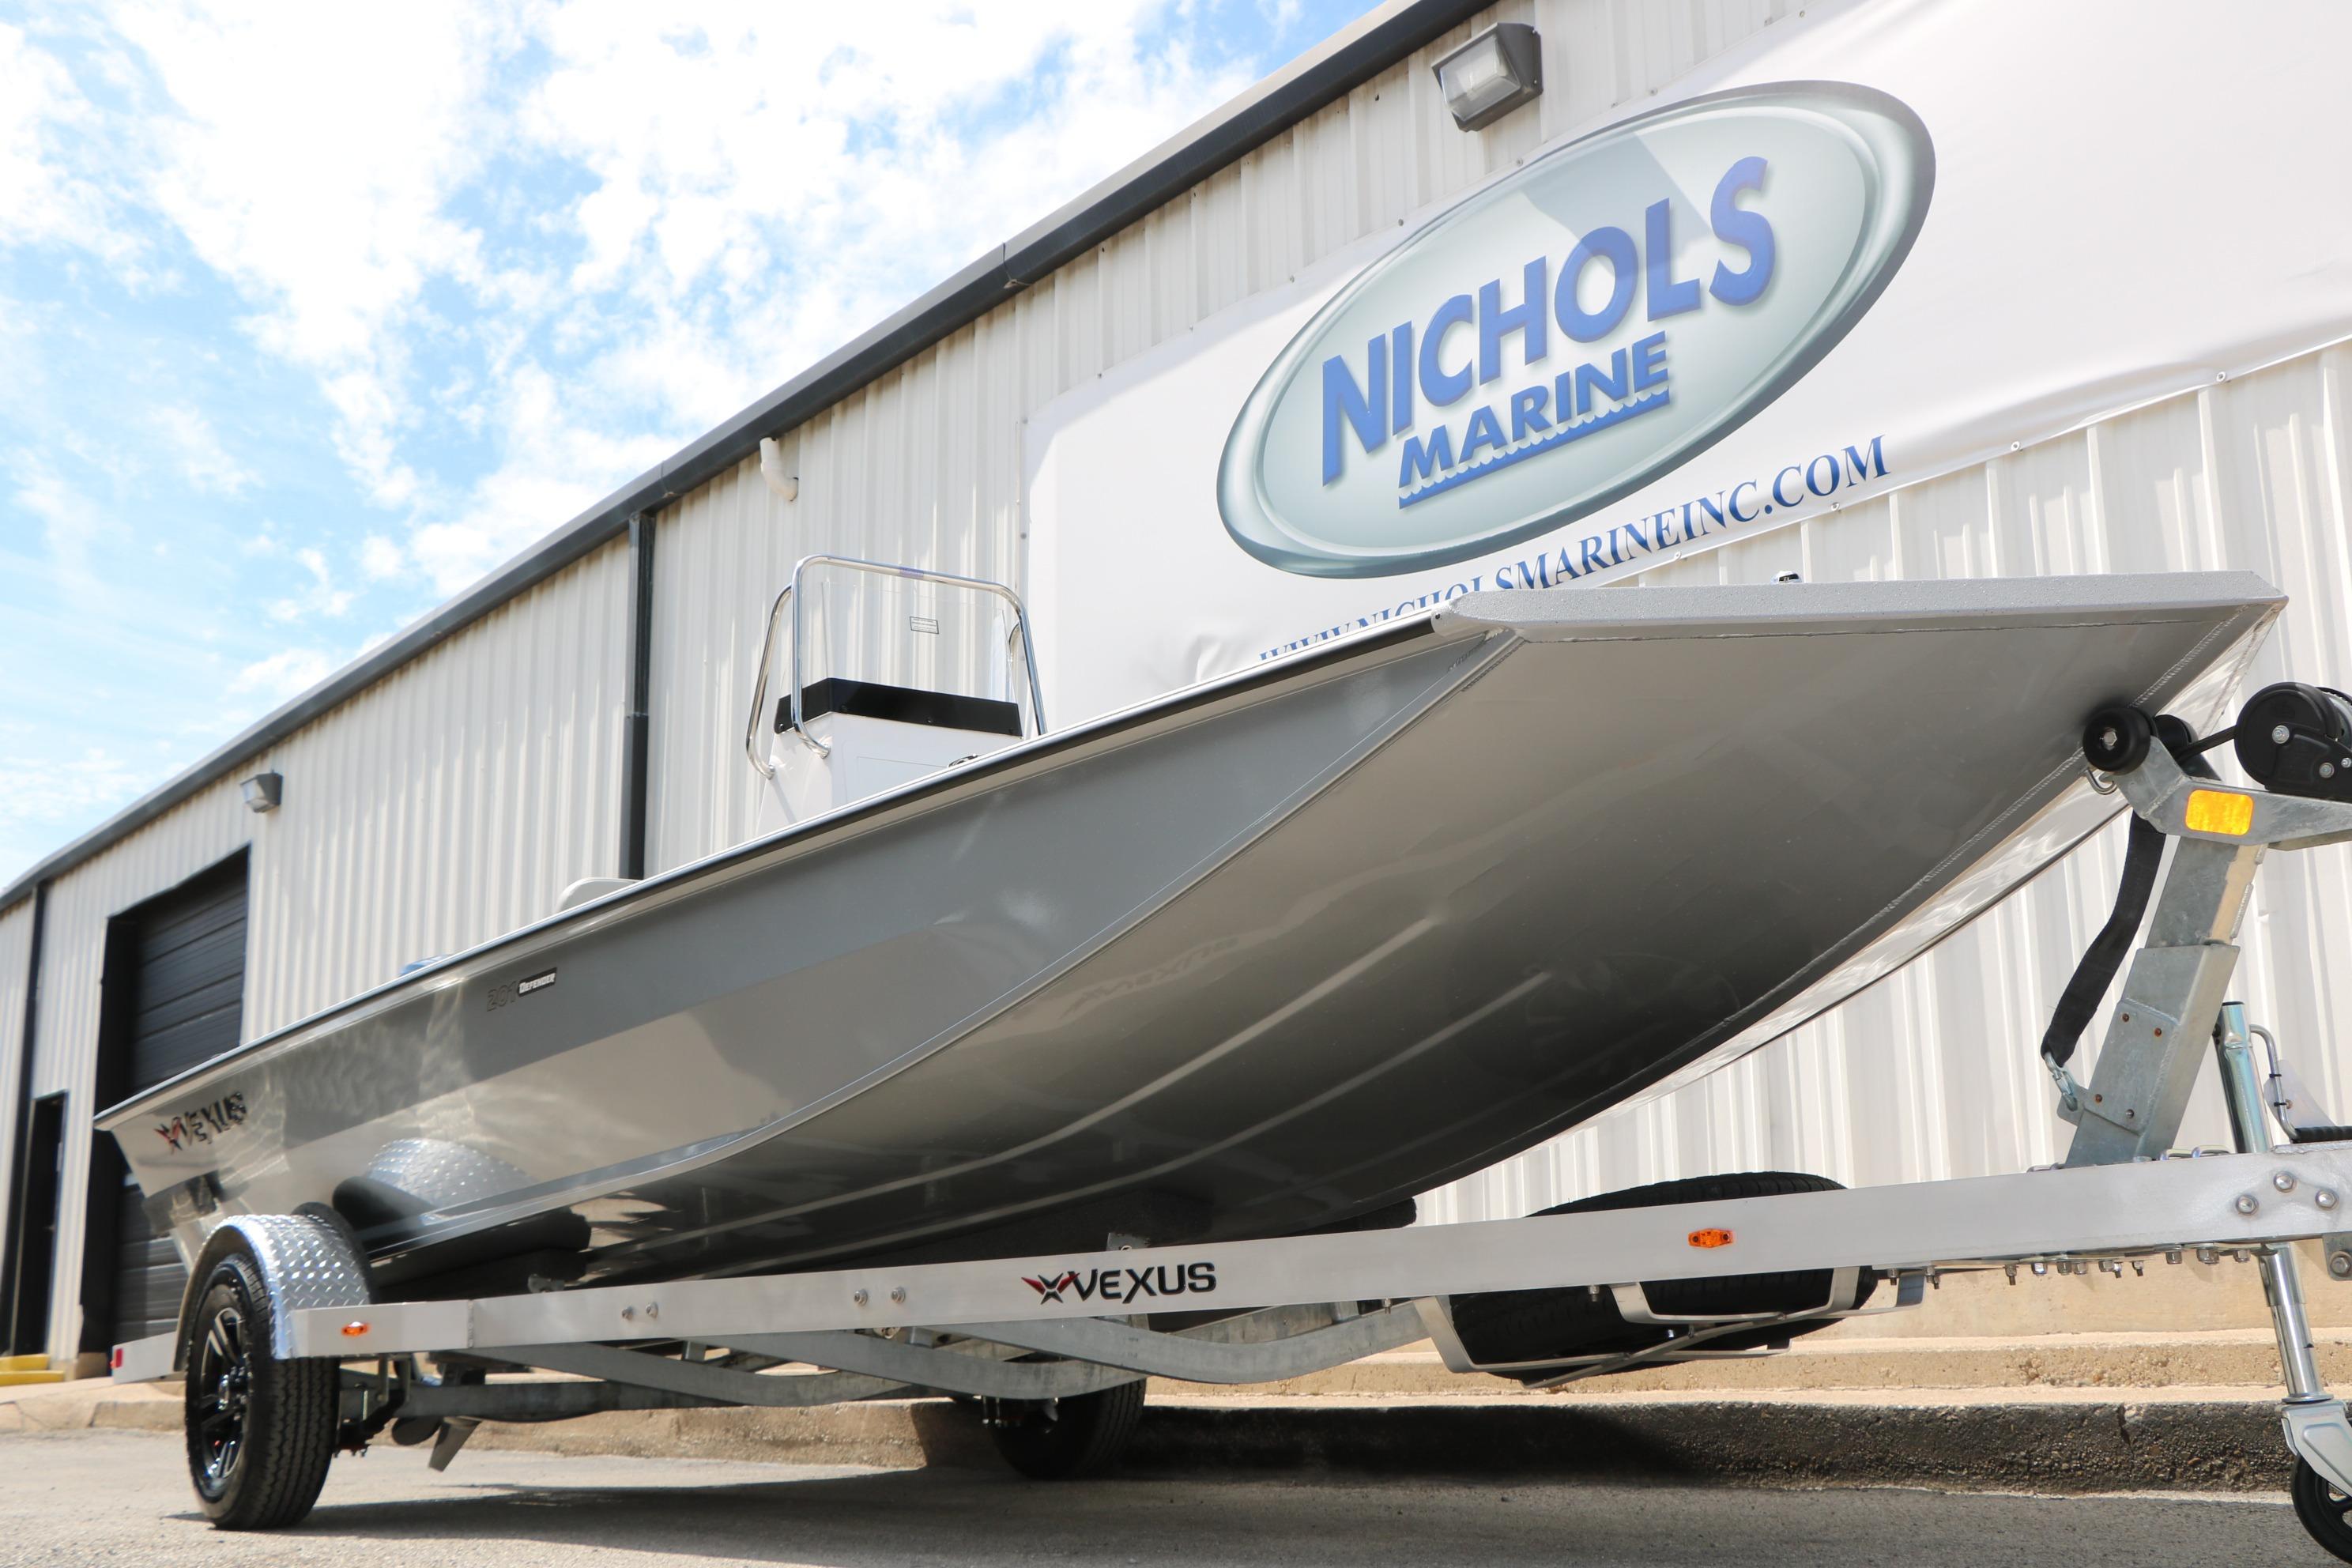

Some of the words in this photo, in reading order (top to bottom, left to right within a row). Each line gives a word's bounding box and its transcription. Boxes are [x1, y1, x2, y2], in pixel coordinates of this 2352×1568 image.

[1322, 156, 1776, 487] NICHOLS
[1398, 330, 1670, 488] MARINE
[1258, 434, 1891, 661] SMARINEINC.COM
[1067, 1262, 1217, 1304] VEXUS
